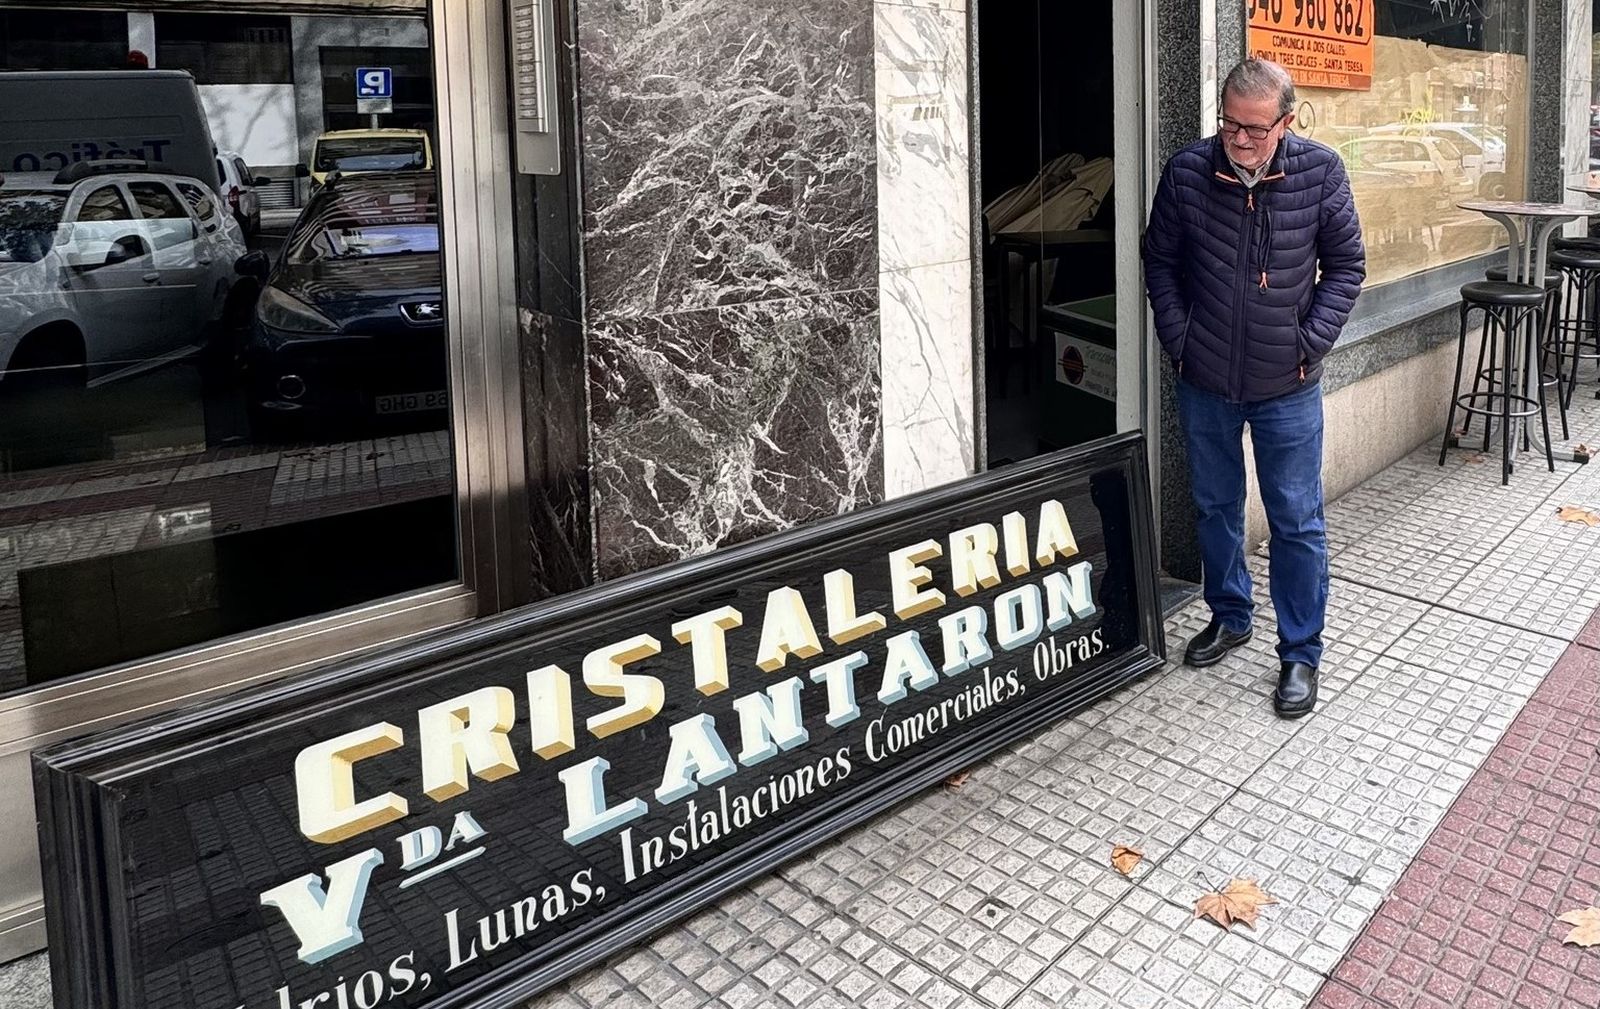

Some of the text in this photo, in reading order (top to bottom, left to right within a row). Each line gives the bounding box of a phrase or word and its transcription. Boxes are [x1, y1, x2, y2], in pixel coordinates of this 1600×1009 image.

[1272, 35, 1305, 52] COMUNICA
[1313, 41, 1325, 54] DOS
[1279, 52, 1294, 66] TRES
[1296, 54, 1317, 69] CRUCES
[1324, 58, 1342, 71] SANTA
[1345, 60, 1364, 73] TERESA
[1334, 0, 1363, 37] 862
[294, 499, 1079, 844] CRISTALERIA
[558, 561, 1097, 846] LANTARON
[445, 867, 607, 973] Lunas,
[620, 744, 853, 883] Instalaciones
[864, 667, 1027, 763] Comerciales,
[1034, 624, 1110, 683] Obras.
